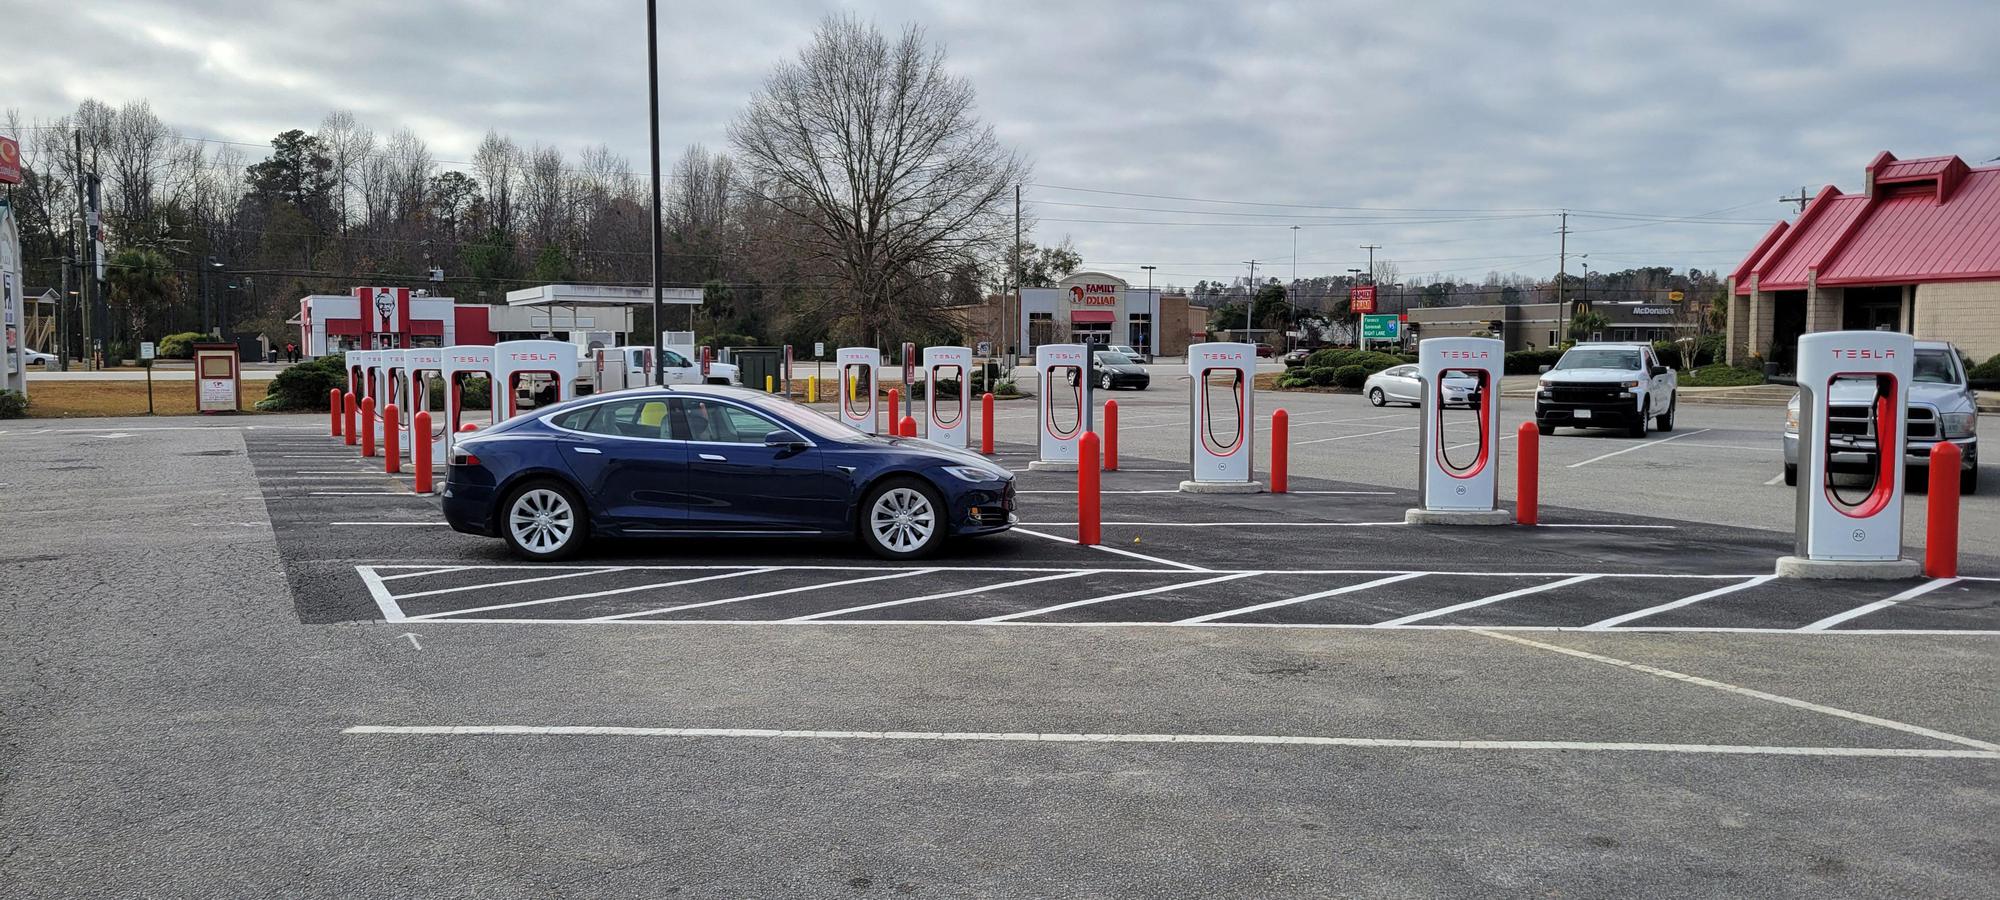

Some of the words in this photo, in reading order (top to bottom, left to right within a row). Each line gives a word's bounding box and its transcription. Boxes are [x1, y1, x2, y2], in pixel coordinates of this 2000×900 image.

[1086, 284, 1115, 293] FAMILY
[1086, 296, 1115, 305] DOLLAR
[1633, 307, 1675, 315] McDonald's
[1831, 349, 1895, 359] TESLA
